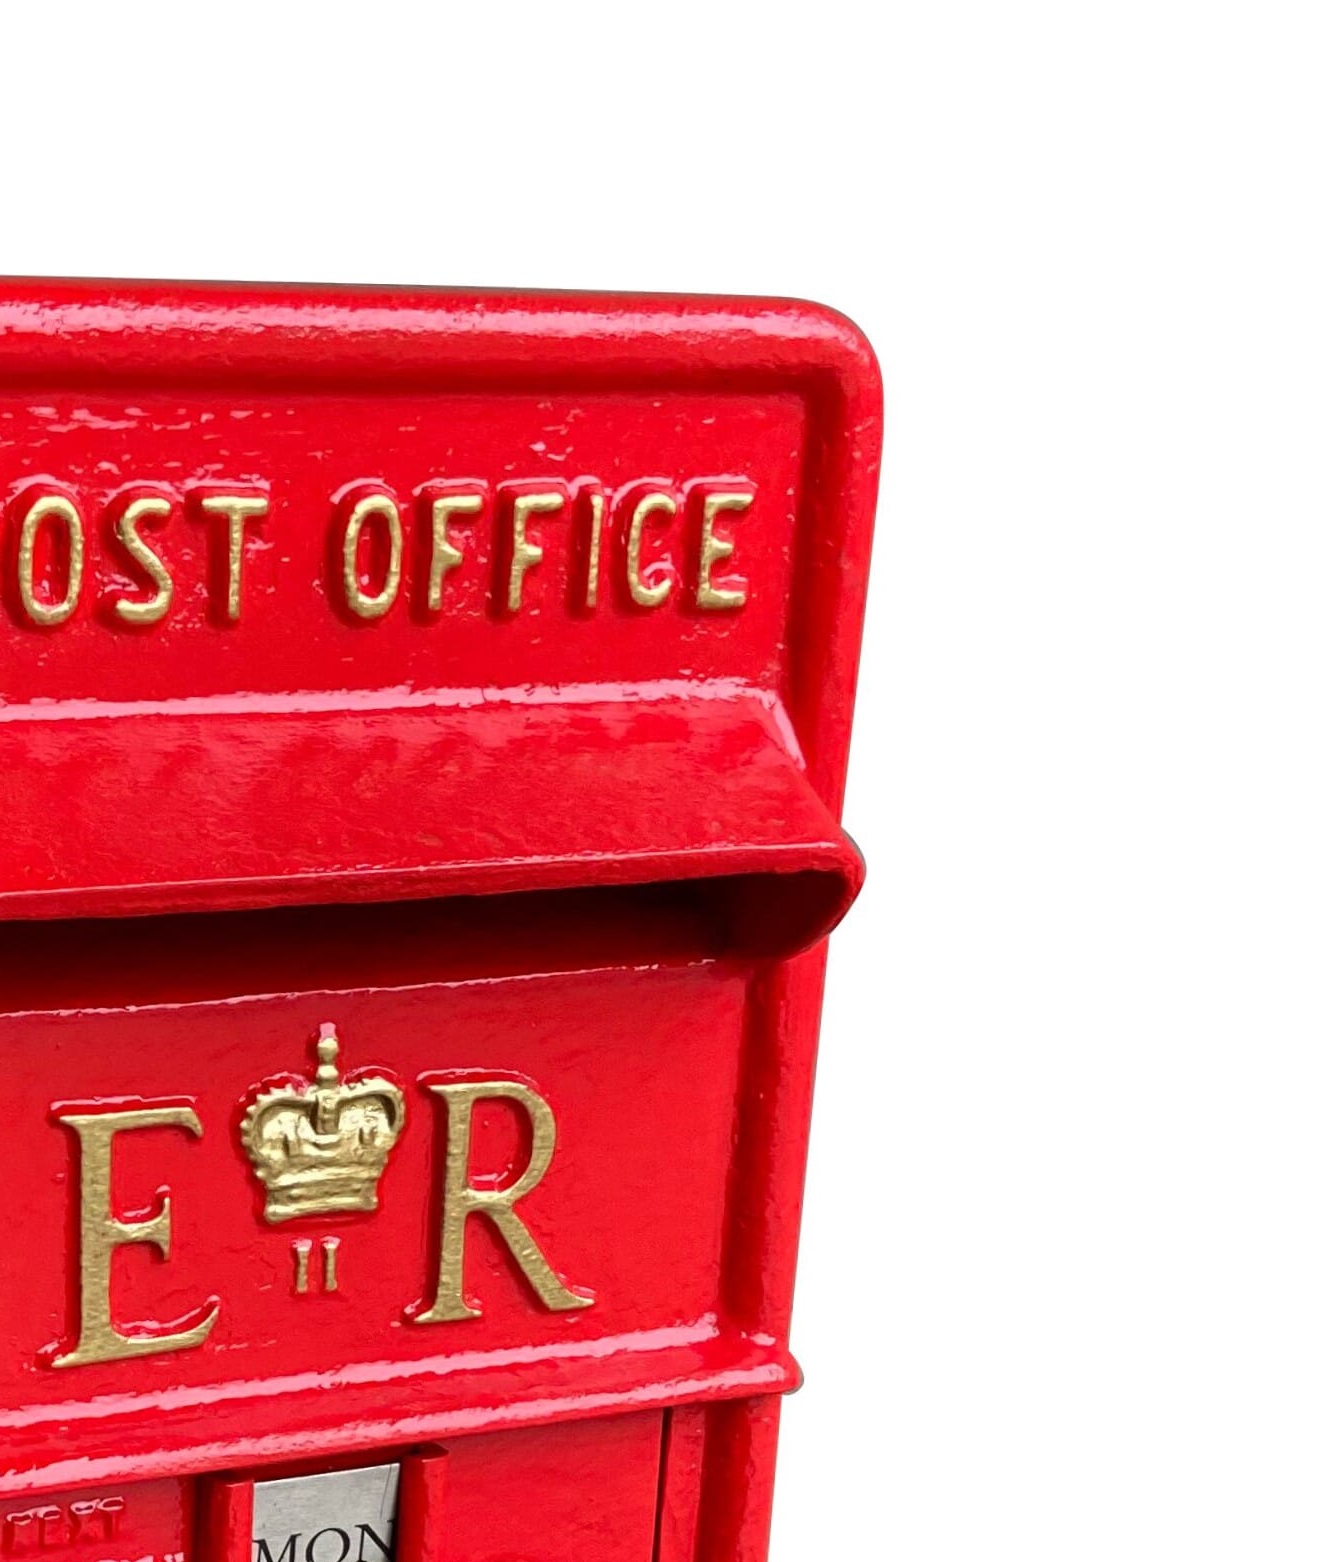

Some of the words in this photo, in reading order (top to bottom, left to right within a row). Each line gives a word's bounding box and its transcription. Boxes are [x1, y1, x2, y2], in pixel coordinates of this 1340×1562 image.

[342, 492, 755, 620] OFFICE
[51, 1106, 220, 1368] E
[413, 1080, 596, 1325] R
